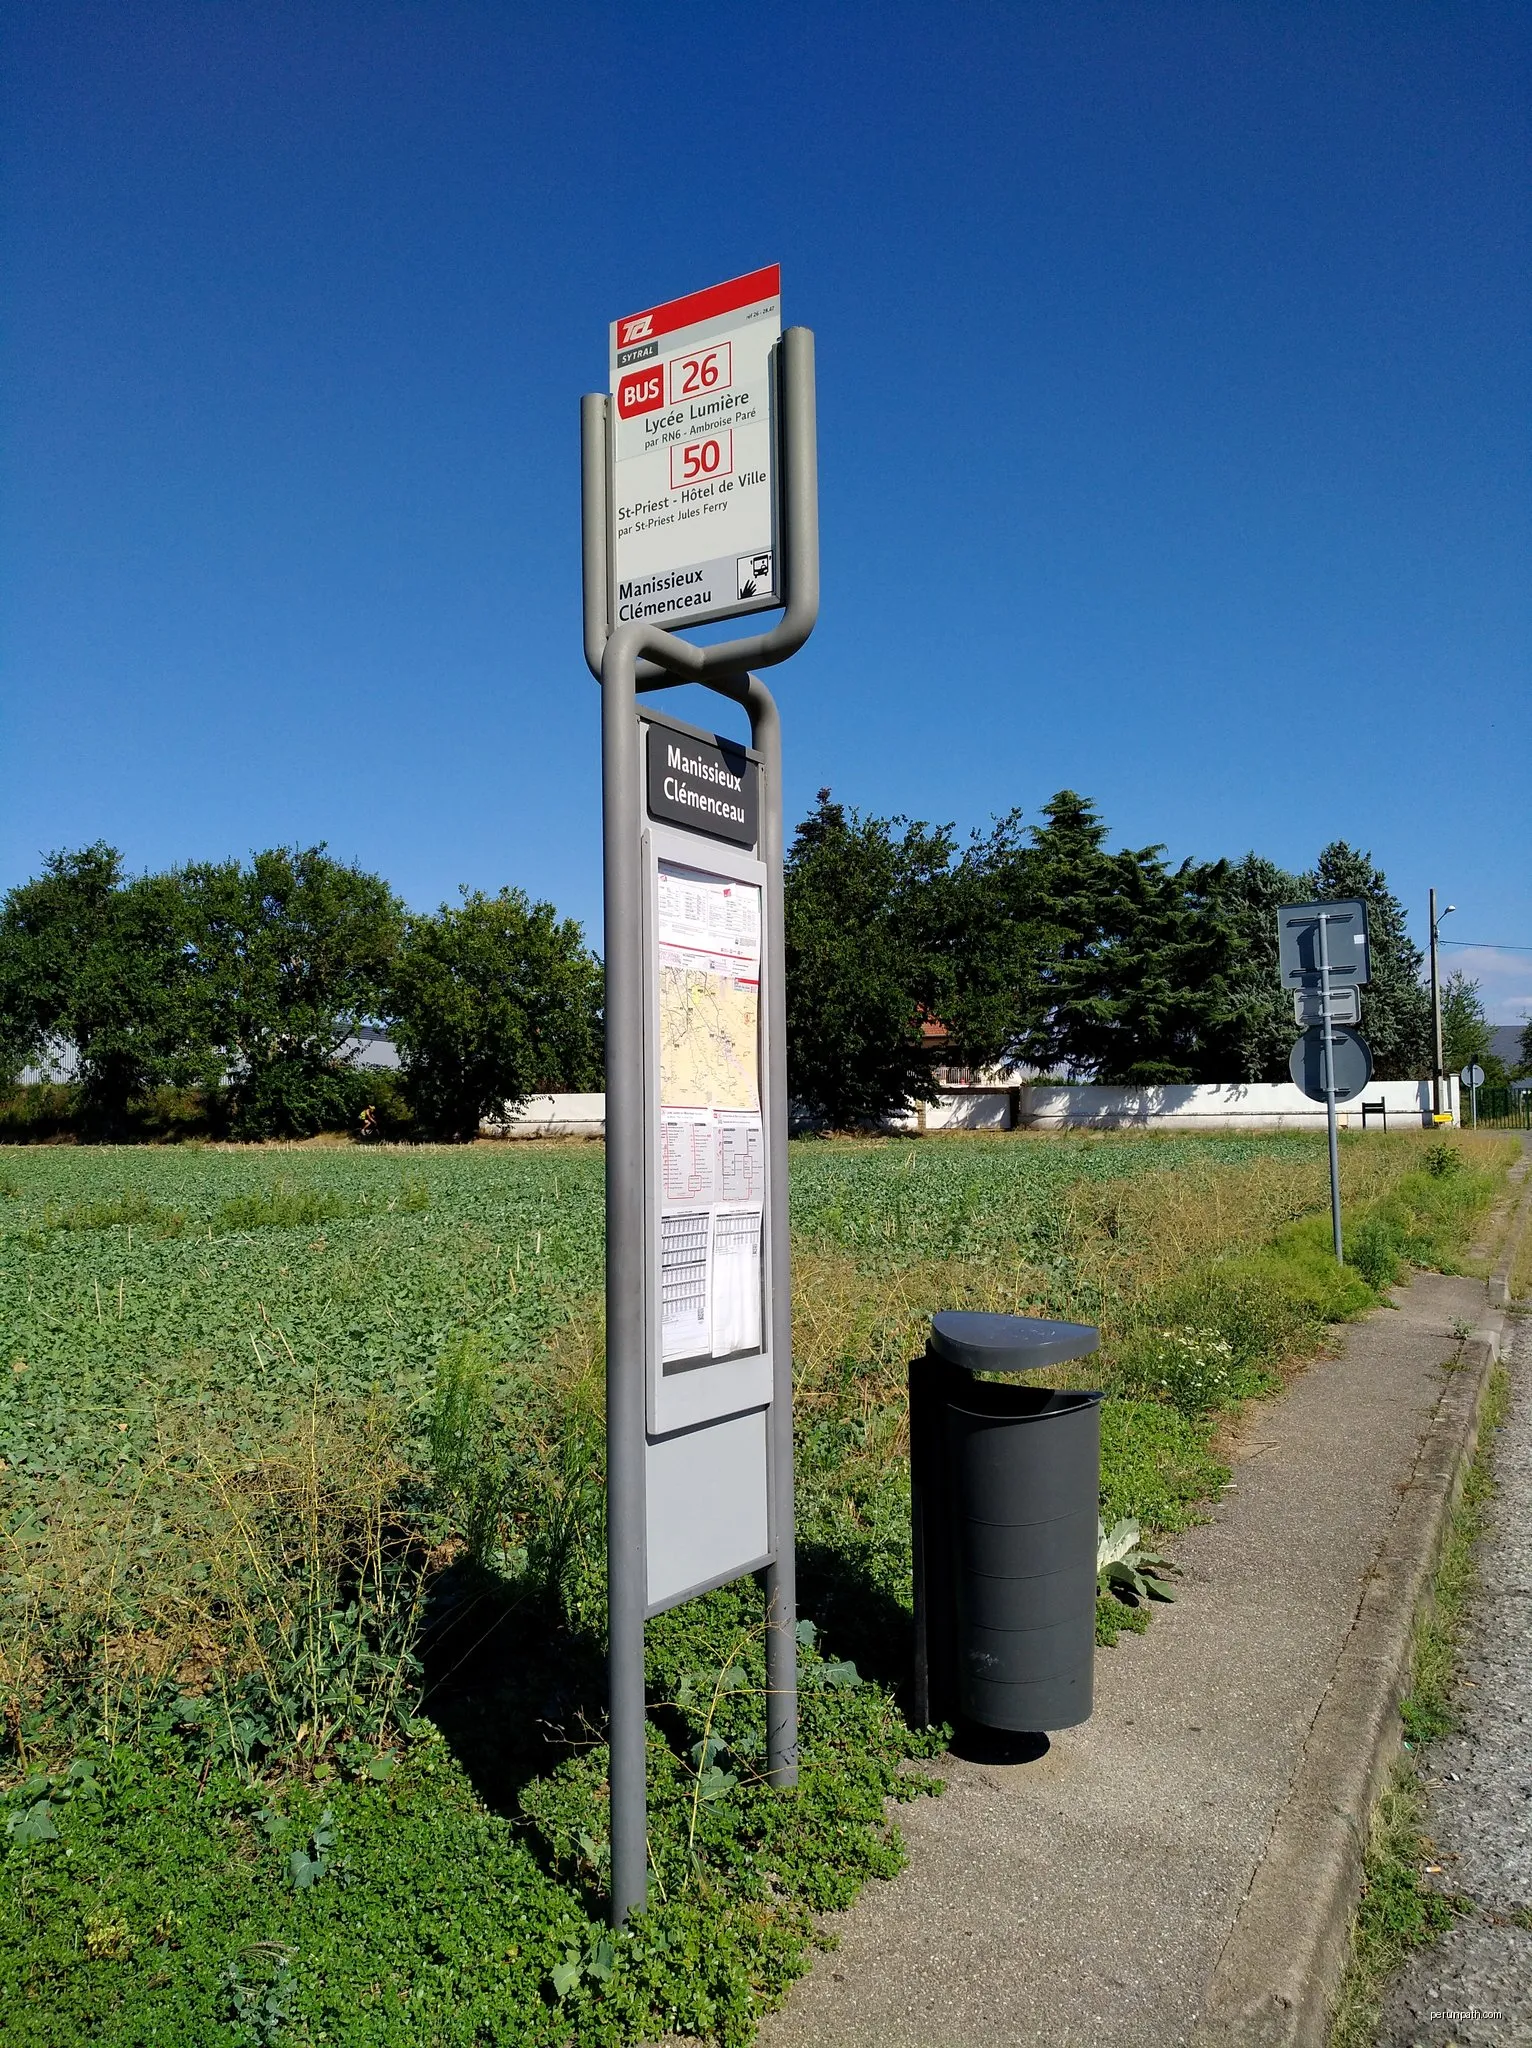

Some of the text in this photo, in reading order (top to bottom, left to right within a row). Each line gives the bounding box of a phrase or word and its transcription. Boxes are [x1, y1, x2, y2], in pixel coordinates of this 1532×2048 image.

[624, 314, 653, 343] TCL
[621, 347, 653, 364] SYTRAL
[624, 354, 719, 407] BUS 26
[644, 440, 659, 450] par
[662, 431, 681, 444] RN6
[689, 417, 732, 436] Ambroise
[735, 407, 756, 421] Paré
[645, 392, 749, 433] Lycée Lumière
[684, 440, 720, 478] 50
[618, 499, 669, 521] St-Priest
[681, 486, 714, 504] Hôtel
[719, 480, 733, 492] de
[738, 470, 766, 486] Ville
[618, 500, 728, 538] par St-Priest Jules Ferry
[620, 569, 703, 600] Manissieux
[620, 588, 712, 622] Clémenceau
[667, 744, 742, 792] Manissieux
[663, 776, 745, 824] Clémenceau
